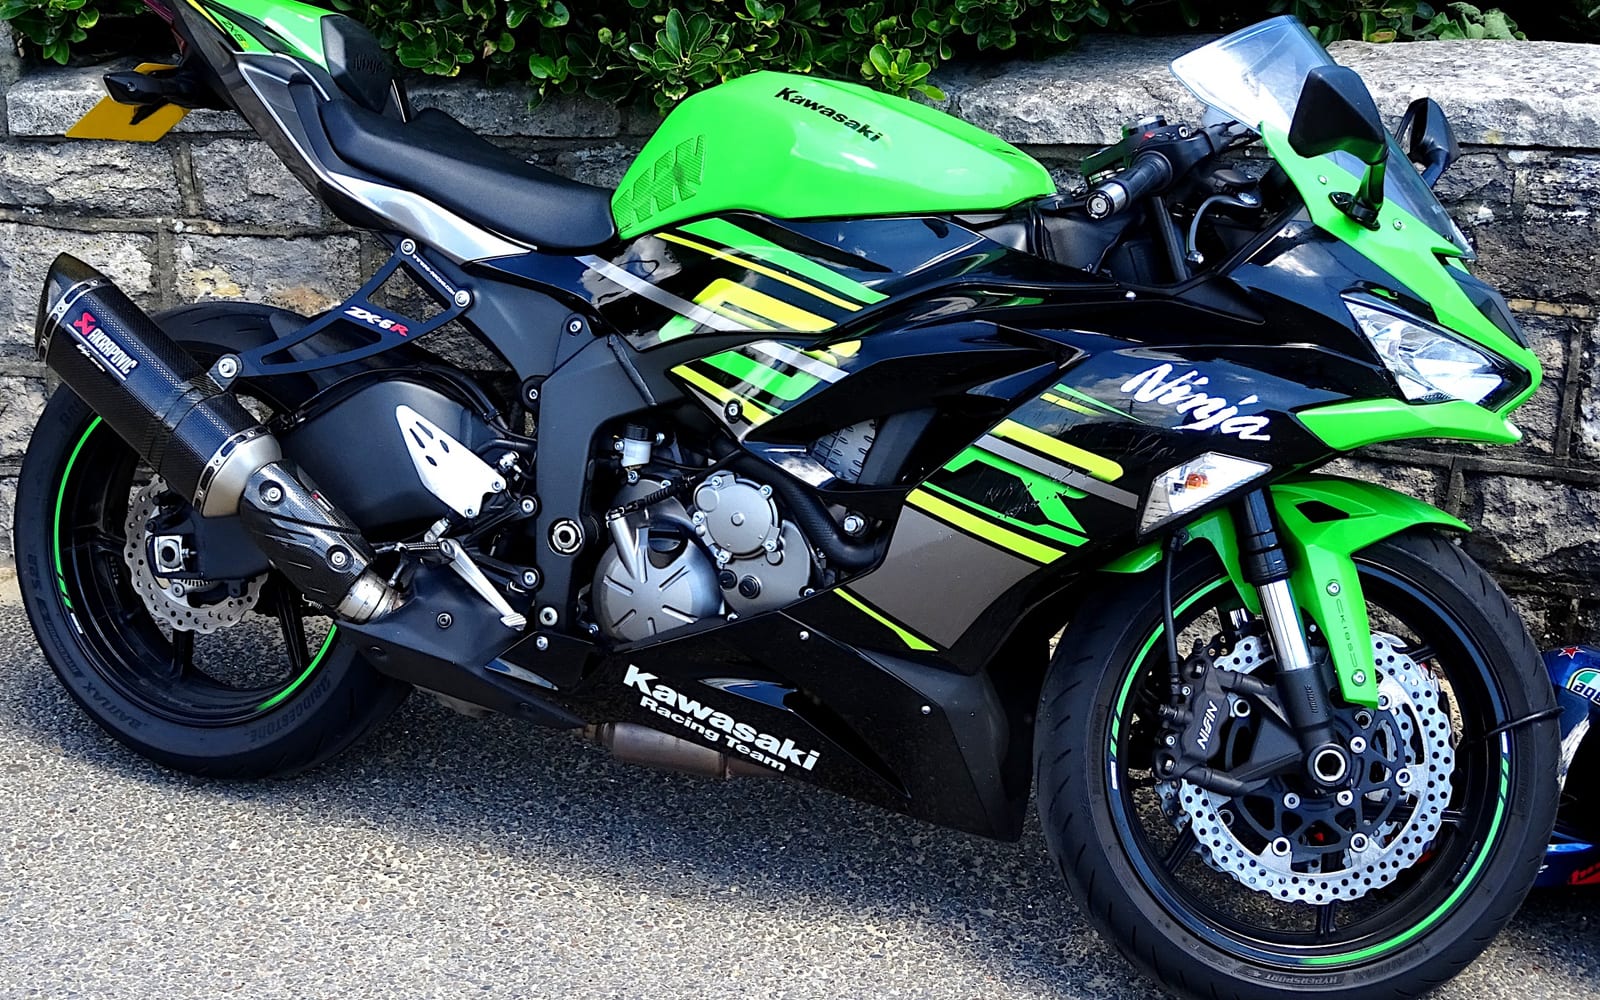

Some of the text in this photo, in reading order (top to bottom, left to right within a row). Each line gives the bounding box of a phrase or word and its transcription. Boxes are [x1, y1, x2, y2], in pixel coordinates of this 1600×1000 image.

[773, 86, 884, 143] Kawasaki
[344, 306, 409, 336] ZX-6R
[1120, 363, 1271, 441] Ninja
[623, 664, 820, 771] Kawasaki
[639, 696, 786, 772] Racing Team
[1264, 973, 1338, 985] HYPERSPORT
